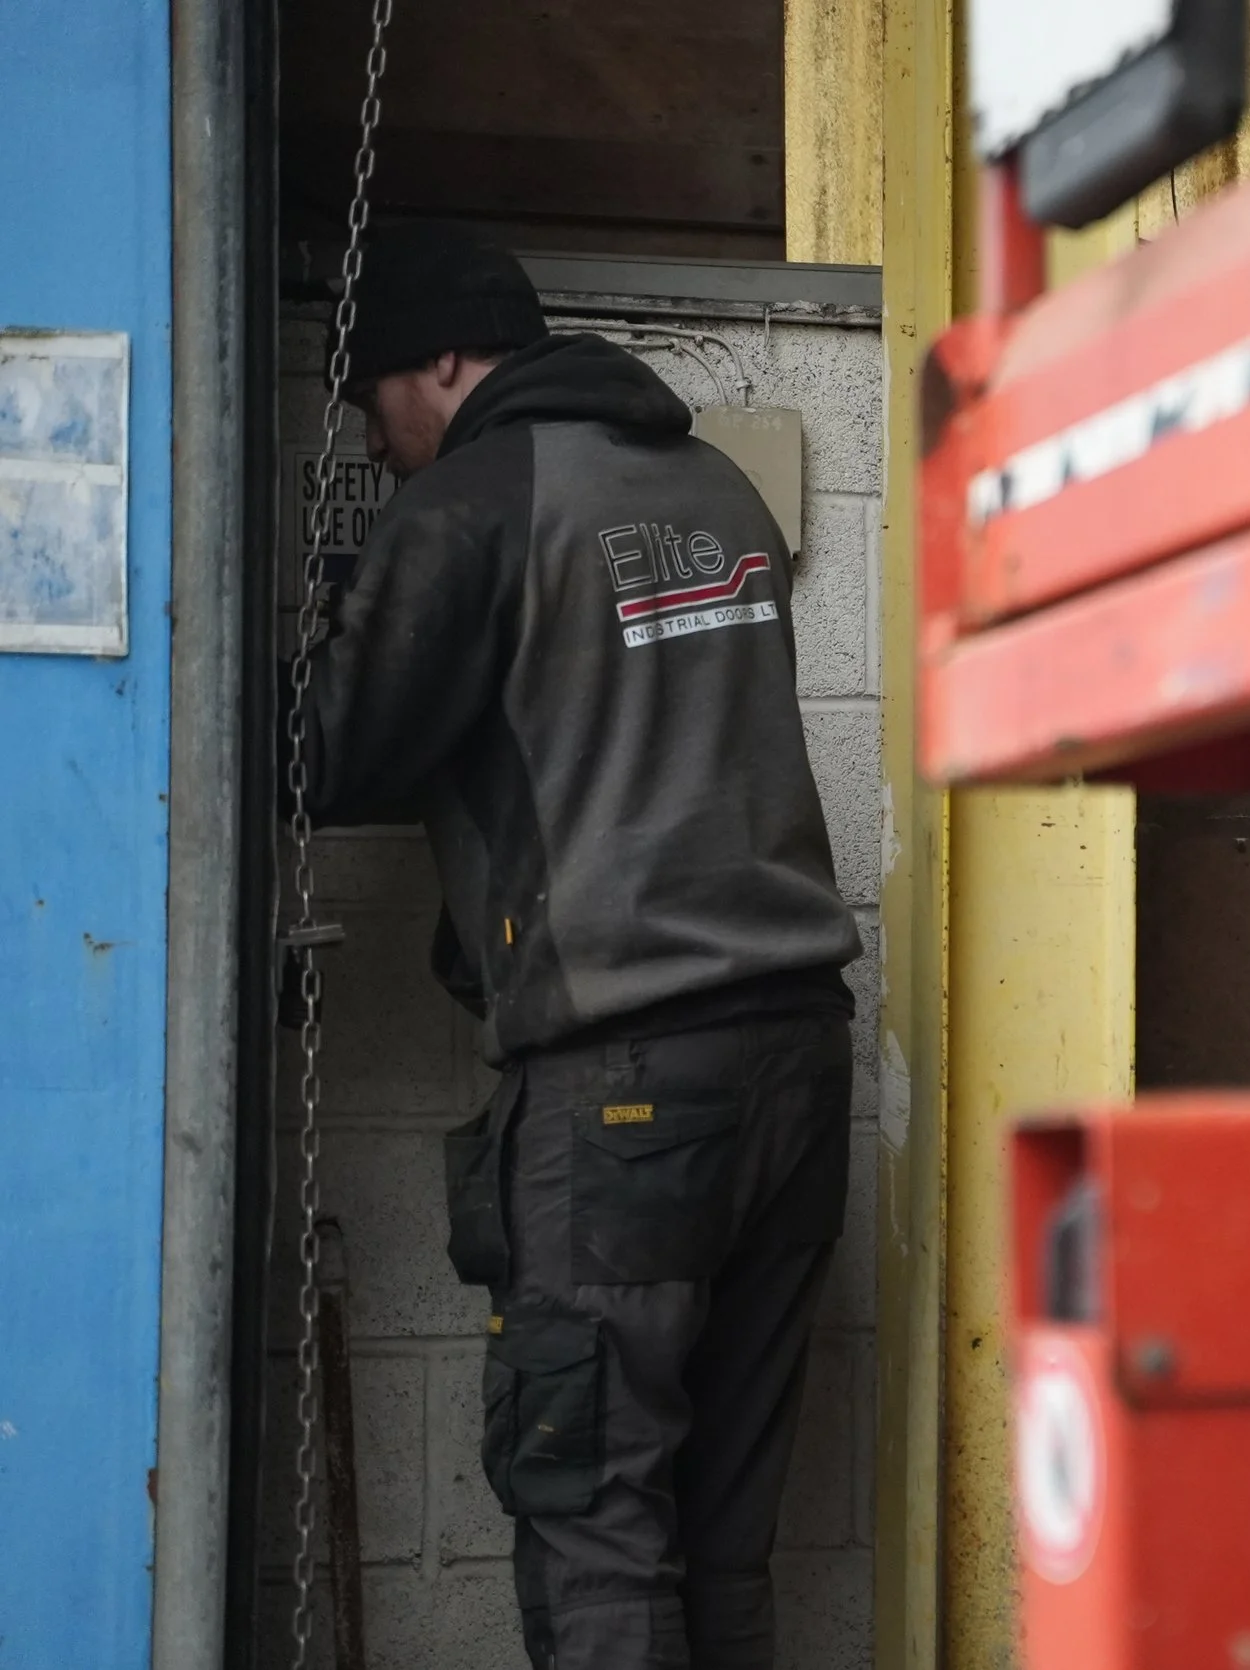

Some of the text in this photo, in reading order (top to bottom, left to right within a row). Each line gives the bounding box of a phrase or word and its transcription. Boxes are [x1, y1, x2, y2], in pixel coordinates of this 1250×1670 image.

[303, 461, 384, 501] SAFETY
[303, 507, 344, 546] USE
[599, 523, 724, 592] Elite
[626, 615, 710, 644] INDSTRIAL
[760, 603, 775, 617] LT
